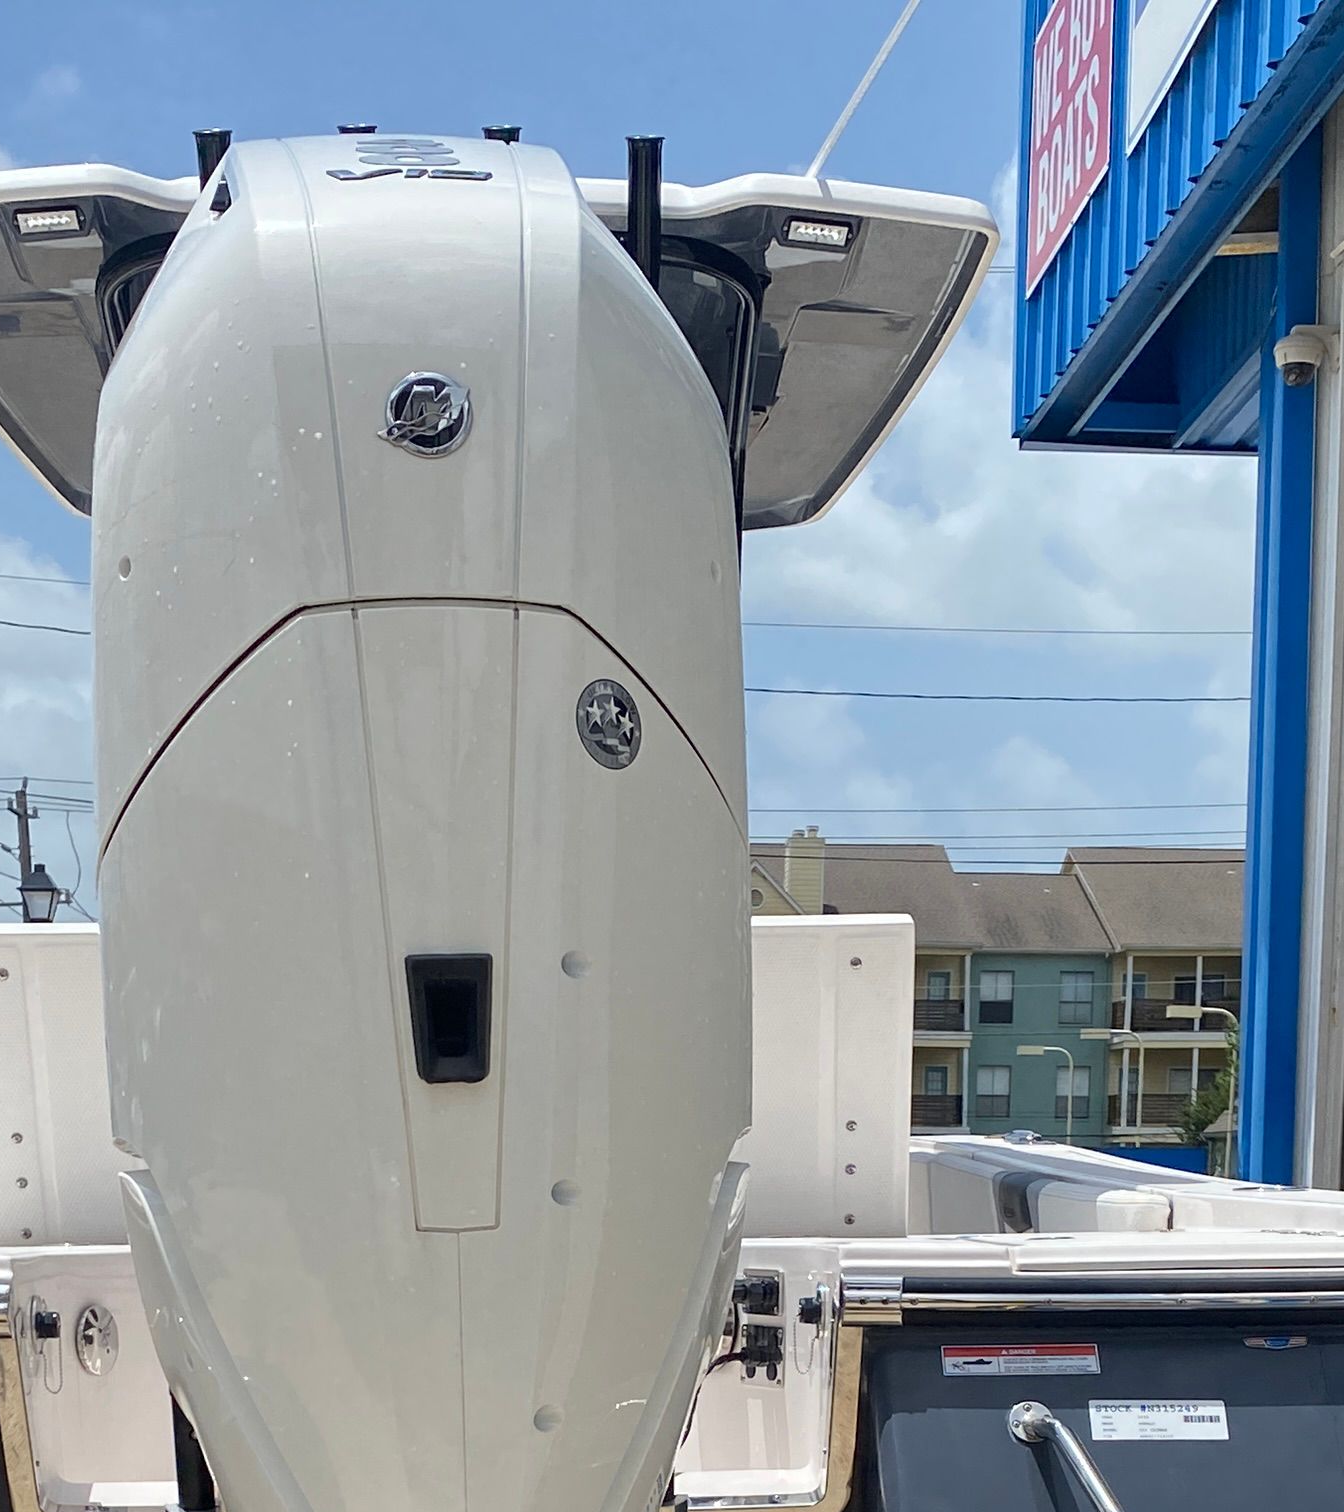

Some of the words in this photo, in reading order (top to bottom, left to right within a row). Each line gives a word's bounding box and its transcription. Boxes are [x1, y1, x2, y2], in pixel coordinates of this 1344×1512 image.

[1035, 6, 1065, 151] WE
[1068, 0, 1106, 90] BU
[1036, 54, 1100, 257] BOATS
[1095, 1404, 1132, 1413] STOCK
